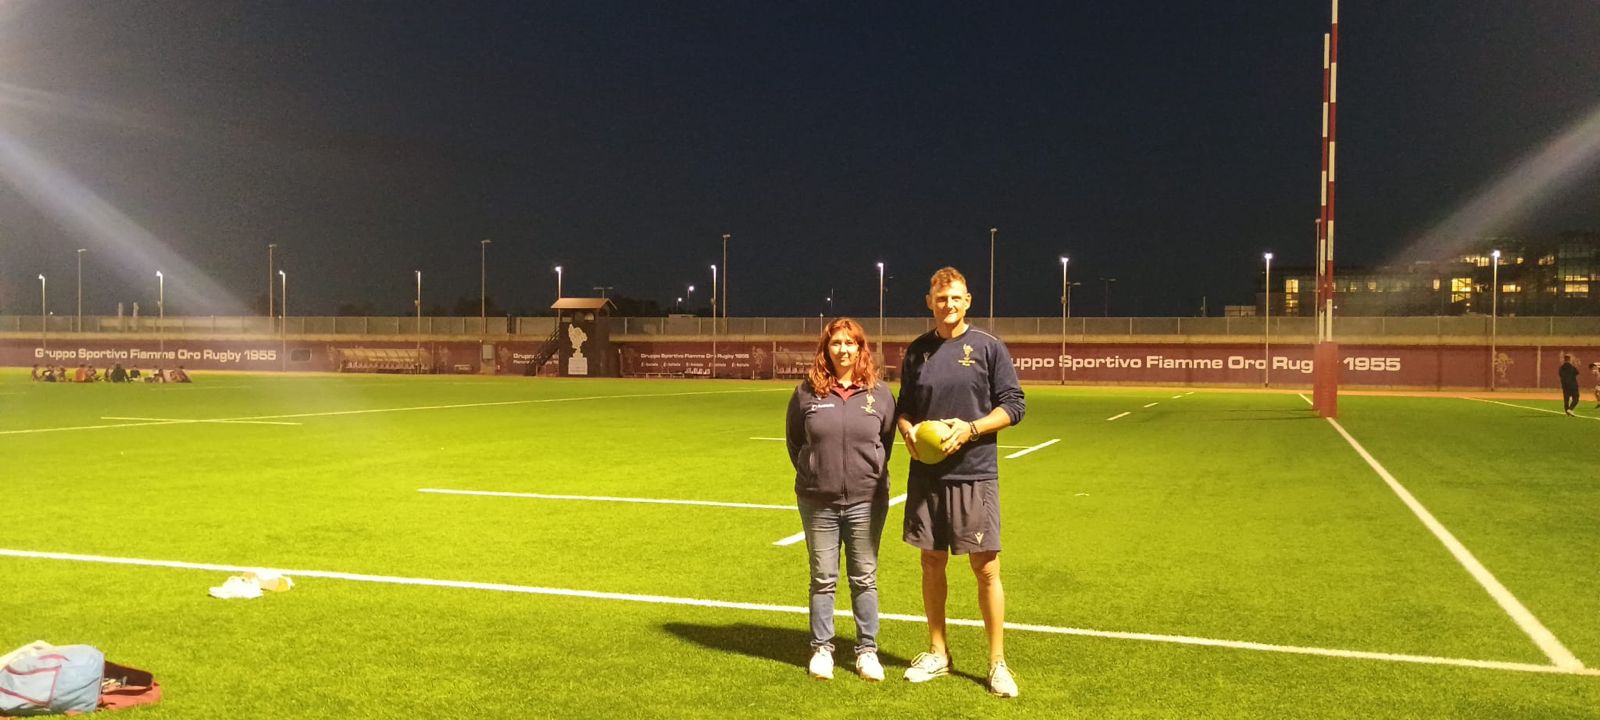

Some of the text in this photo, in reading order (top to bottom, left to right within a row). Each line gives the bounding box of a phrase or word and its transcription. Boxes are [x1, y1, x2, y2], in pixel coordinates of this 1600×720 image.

[78, 348, 128, 361] Sportivo
[130, 349, 174, 360] Fiamme
[177, 349, 201, 360] Oro
[203, 349, 242, 363] Rugby
[244, 350, 277, 361] 1955
[1010, 355, 1401, 374] uppo Sportivo Fiamme Oro Rug 1955
